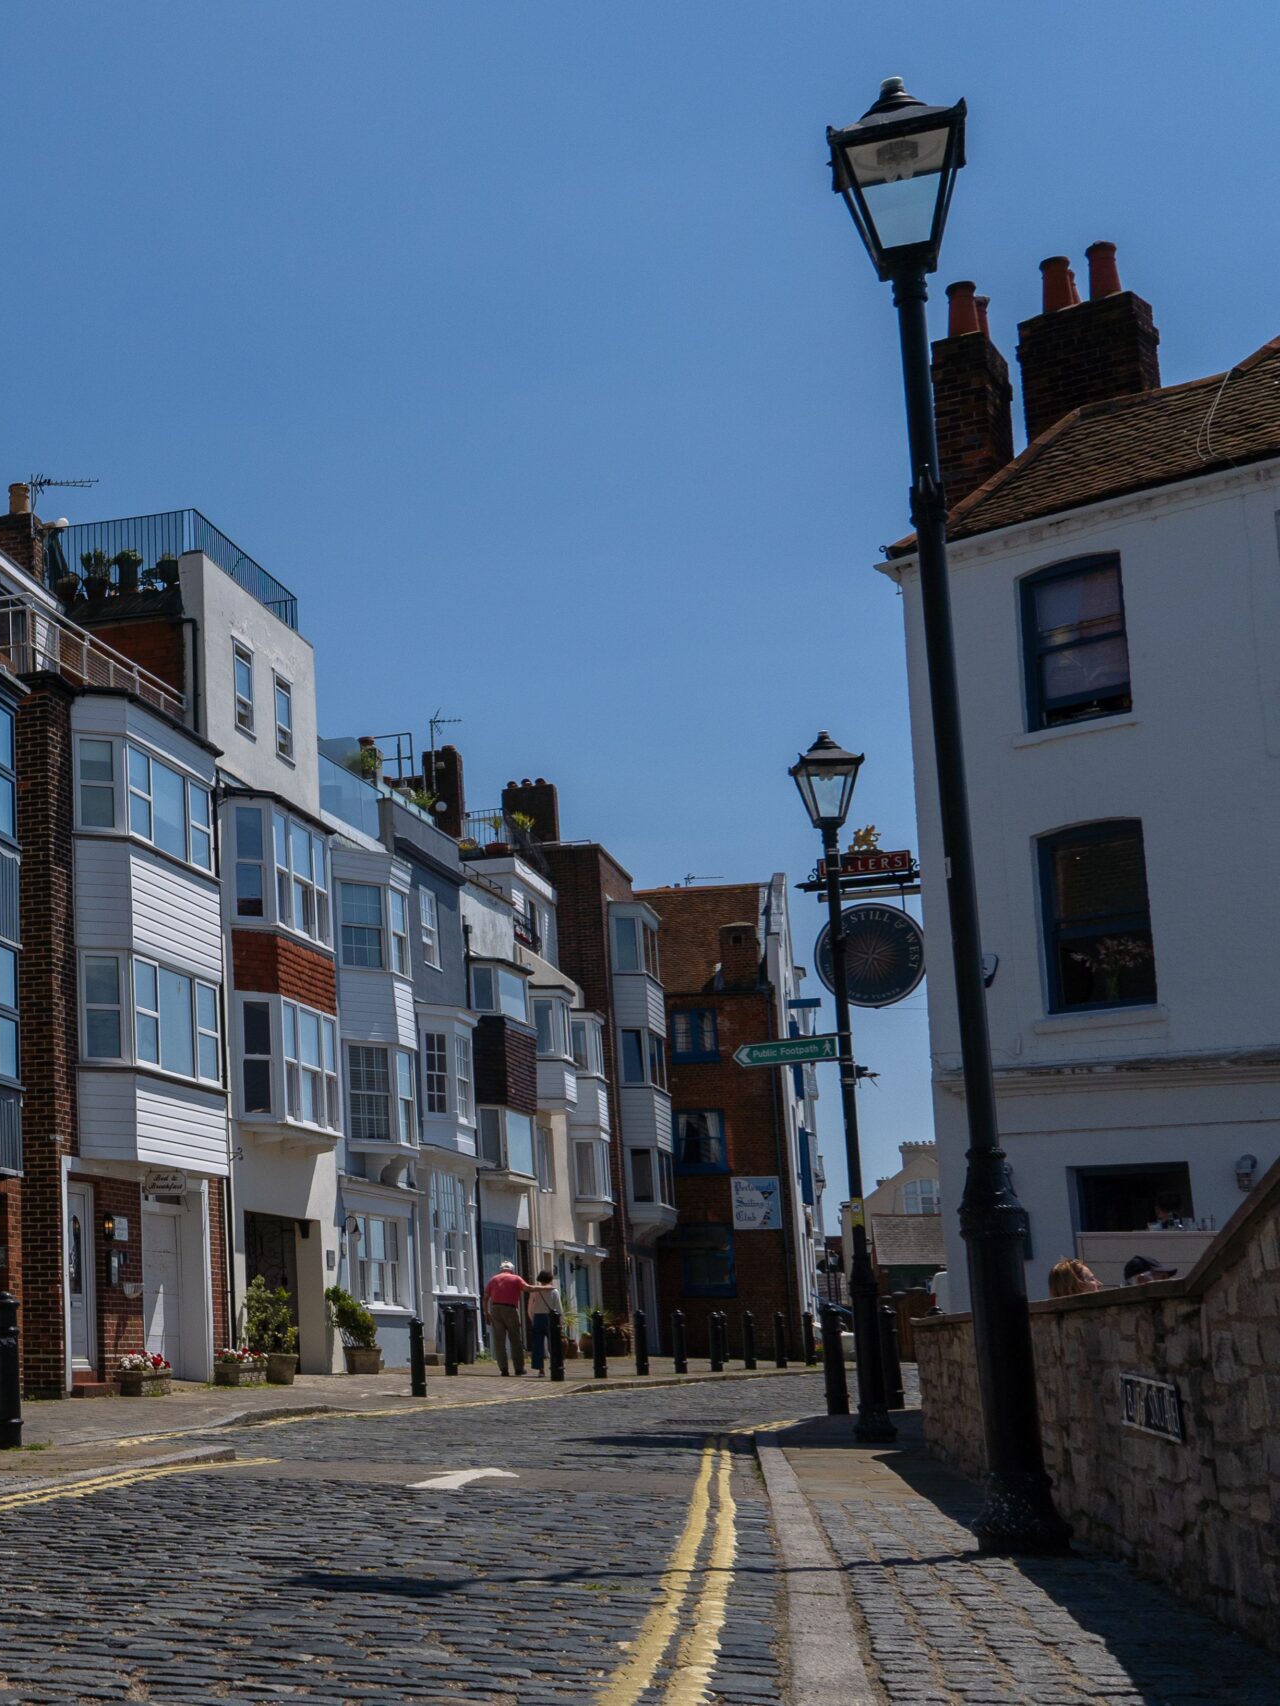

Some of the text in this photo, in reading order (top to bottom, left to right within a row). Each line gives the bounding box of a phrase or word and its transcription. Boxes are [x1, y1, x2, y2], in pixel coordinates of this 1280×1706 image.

[823, 854, 904, 875] LLER'S
[850, 909, 891, 923] STILL
[894, 918, 907, 930] &
[905, 931, 921, 970] WEST
[752, 1044, 819, 1059] Public Footpath
[148, 1181, 183, 1191] Breakfast
